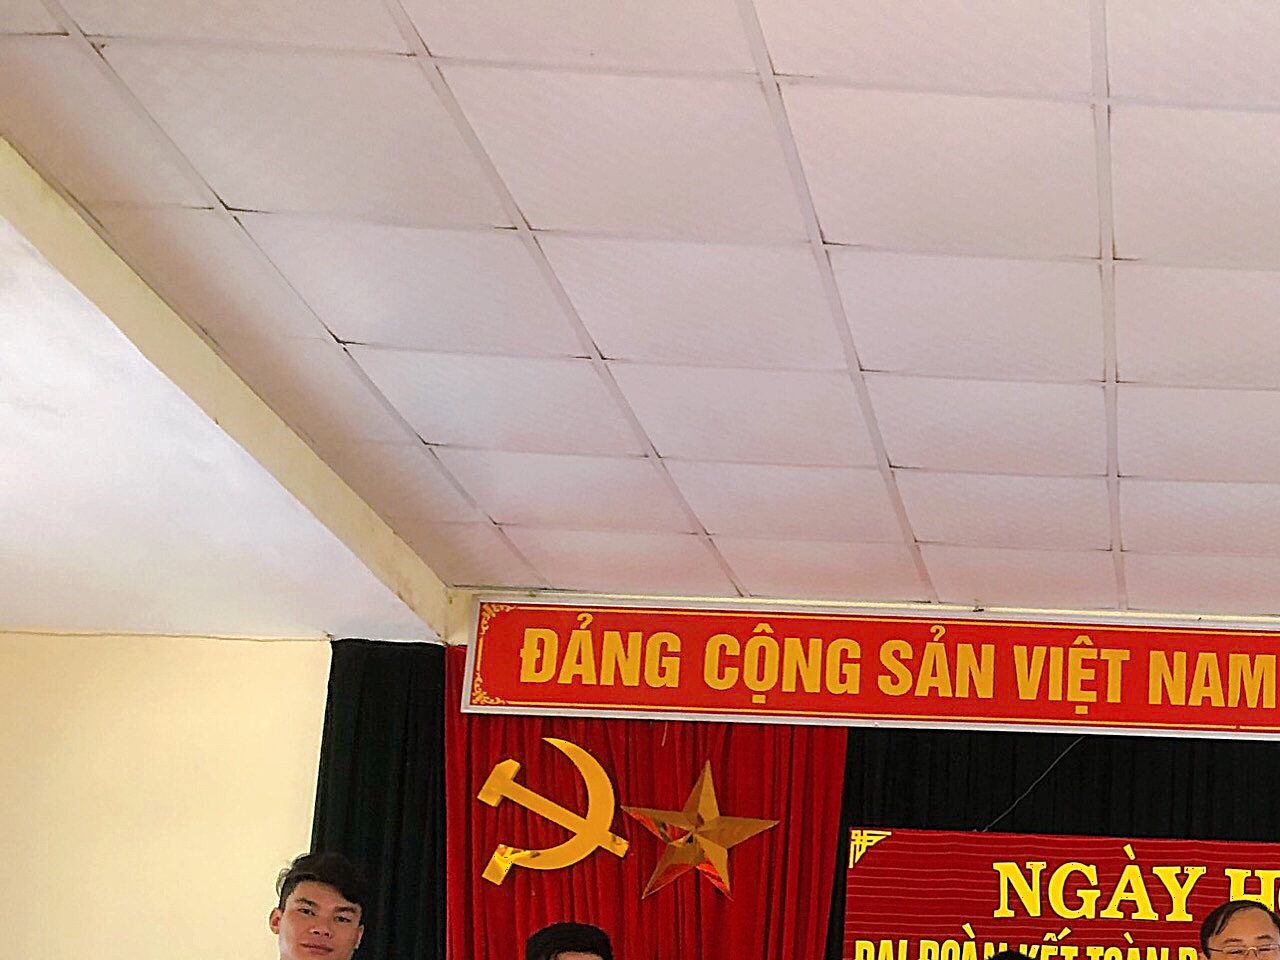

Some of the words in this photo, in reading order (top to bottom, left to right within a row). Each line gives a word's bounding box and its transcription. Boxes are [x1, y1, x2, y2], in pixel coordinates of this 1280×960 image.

[521, 614, 681, 688] ĐẢNG
[704, 623, 861, 704] CỘNG
[878, 624, 995, 699] SẢN
[1013, 635, 1130, 715] VIỆT
[1149, 650, 1277, 709] NAM
[993, 844, 1207, 922] NGÀY
